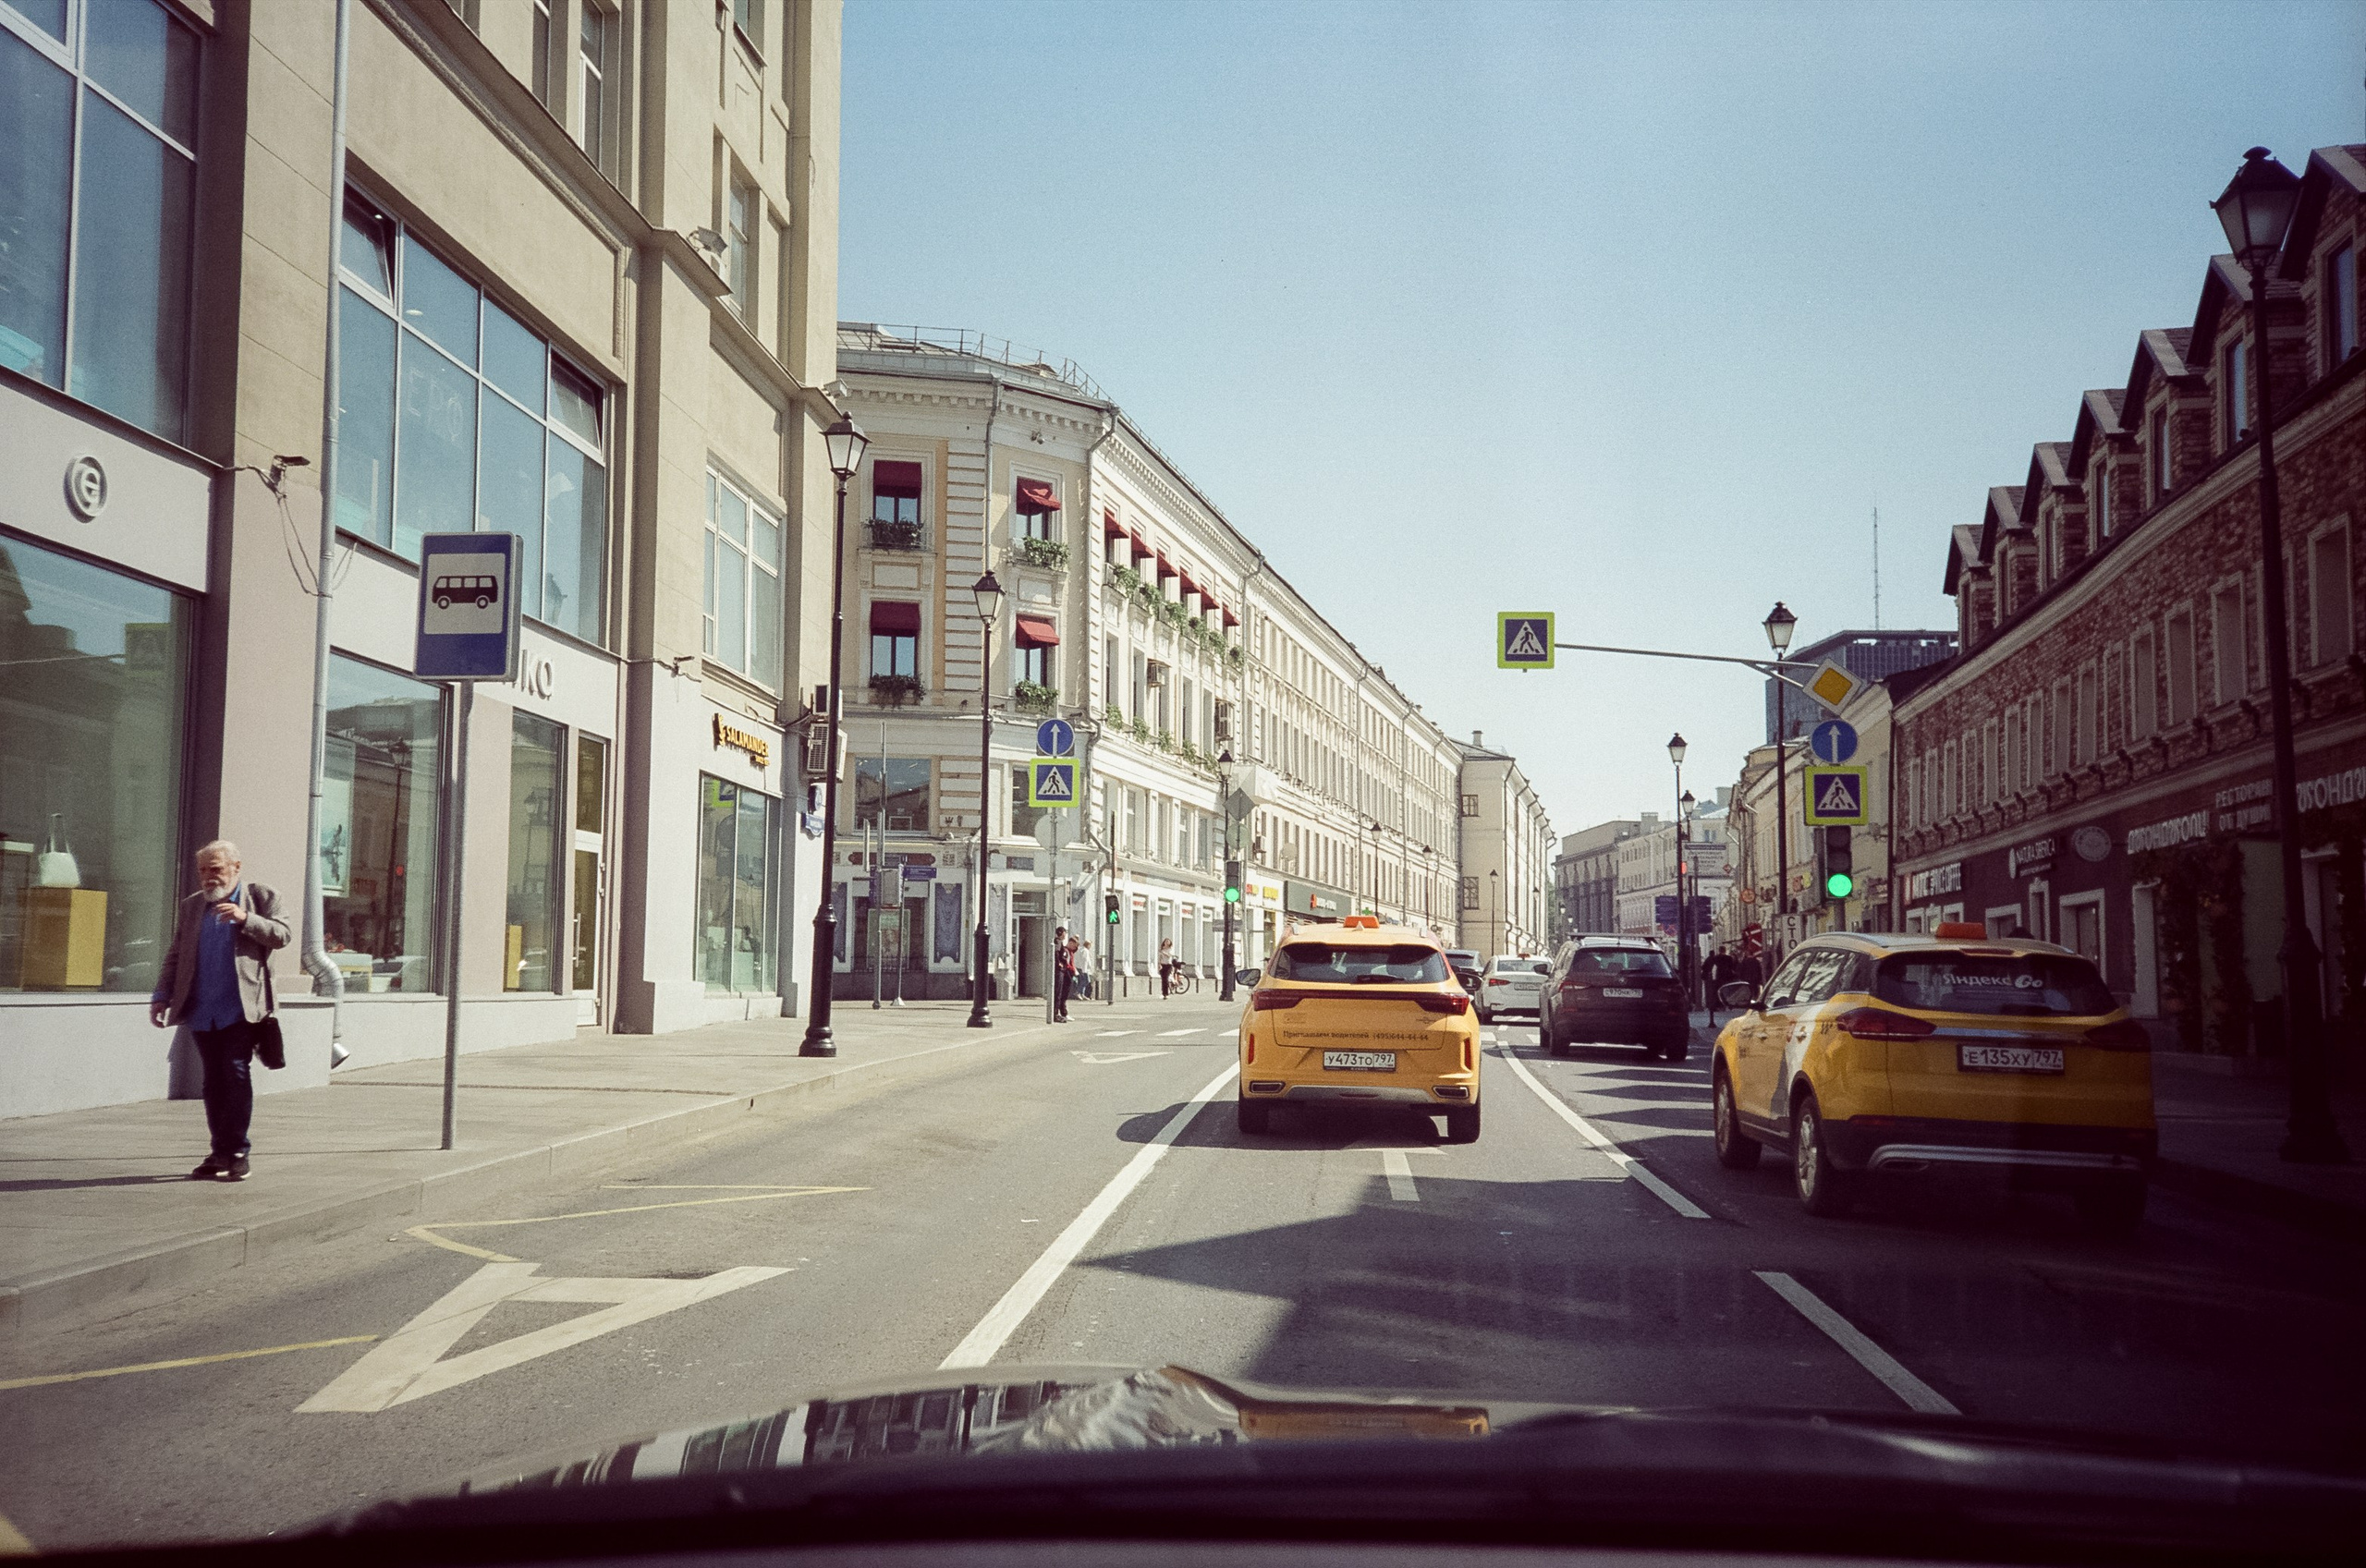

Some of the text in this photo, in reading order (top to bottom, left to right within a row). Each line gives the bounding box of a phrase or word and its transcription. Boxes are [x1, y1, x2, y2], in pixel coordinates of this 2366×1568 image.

[726, 725, 769, 757] SALAMANDER
[1942, 973, 2043, 989] Яндекс Go
[1283, 1030, 1330, 1039] Приглашаем
[1327, 1053, 1393, 1066] У473ТО 797
[1969, 1049, 2059, 1066] Е135ХУ 797
